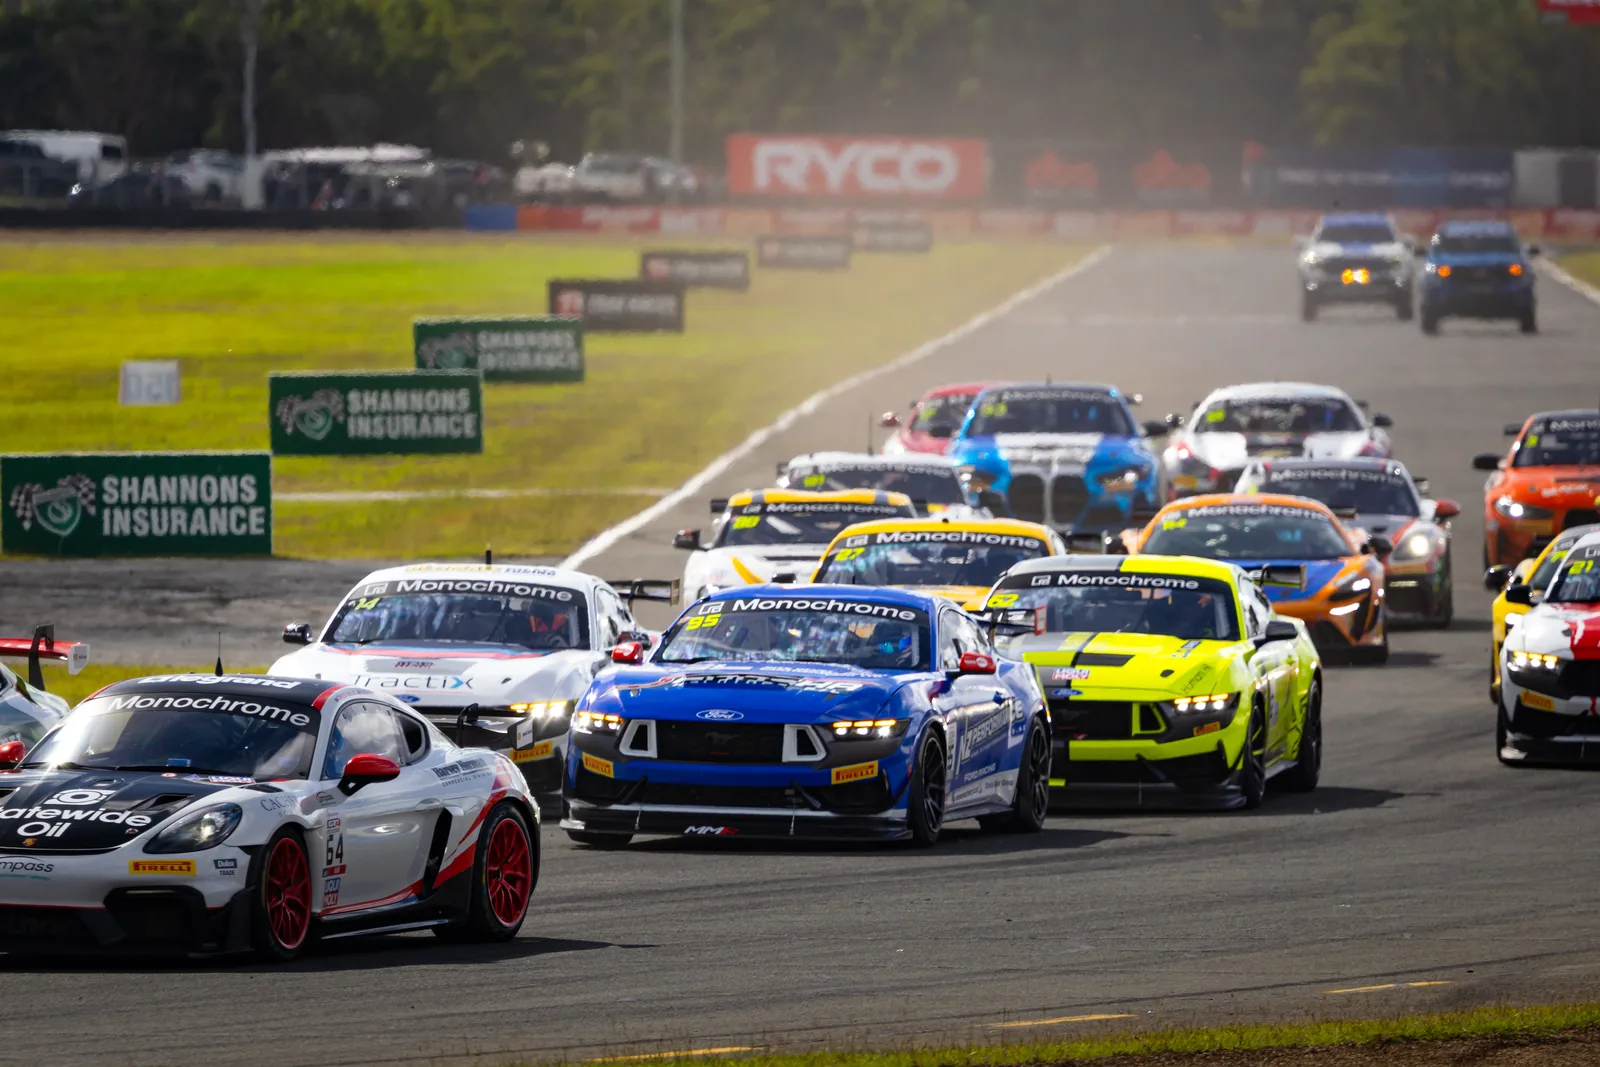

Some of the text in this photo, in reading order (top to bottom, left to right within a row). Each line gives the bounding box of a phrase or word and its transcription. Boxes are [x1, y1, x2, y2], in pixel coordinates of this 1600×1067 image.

[752, 142, 960, 192] RYCO
[477, 329, 575, 349] SHANNONS
[346, 387, 470, 415] SHANNONS
[347, 413, 478, 440] INSURANCE
[102, 474, 257, 505] SHANNONS
[766, 503, 898, 514] Monochrome
[102, 506, 265, 537] INSURANCE
[876, 531, 1041, 549] Monochrome
[396, 579, 573, 602] Monochrome
[1057, 574, 1200, 590] Monochrome
[731, 598, 916, 621] Monochrome
[987, 593, 1019, 608] 62
[685, 613, 722, 631] 95
[107, 695, 310, 727] Monochrome
[431, 763, 460, 778] Harvey
[835, 764, 875, 781] PIRELLI
[17, 821, 72, 837] Oil
[326, 832, 344, 866] 64
[133, 861, 192, 873] PIRELLI
